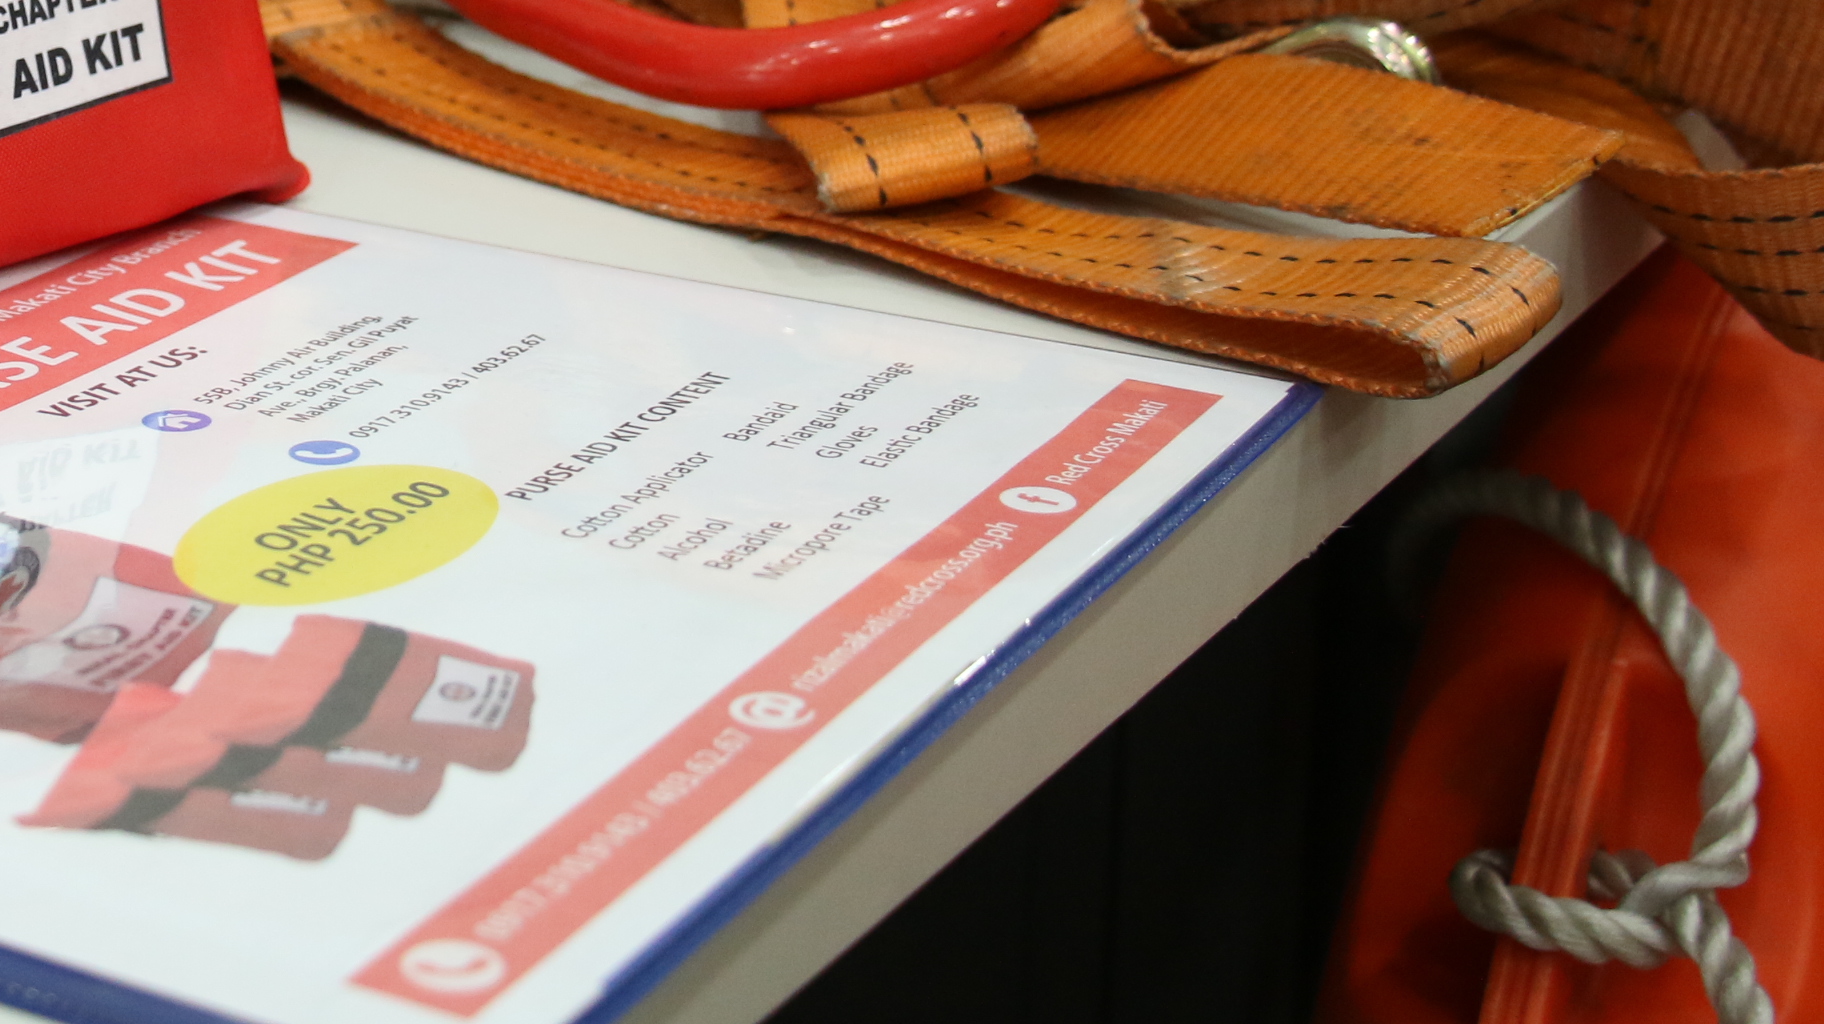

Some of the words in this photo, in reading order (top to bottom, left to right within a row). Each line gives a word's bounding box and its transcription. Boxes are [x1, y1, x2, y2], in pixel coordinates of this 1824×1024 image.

[12, 46, 74, 100] AID
[81, 23, 145, 75] KIT
[59, 288, 186, 346] AID
[165, 239, 282, 293] KIT
[66, 260, 127, 287] City
[110, 228, 204, 265] Branch
[37, 381, 119, 419] VISIT
[114, 366, 160, 388] AT
[152, 345, 209, 371] US:
[224, 389, 273, 411] Dian
[266, 377, 295, 392] St.
[290, 364, 324, 381] cor.
[314, 349, 357, 366] Sen.
[347, 334, 379, 349] Gil
[368, 315, 419, 338] Puyat
[230, 356, 295, 388] Johnny
[287, 345, 317, 359] Air
[287, 392, 352, 423] Makati
[343, 377, 383, 396] City
[295, 375, 346, 399] Brgy.
[334, 343, 409, 378] Palanan,
[348, 377, 470, 438] 0917.310.9143
[471, 333, 546, 375] 403.62.67
[504, 462, 586, 501] PURSE
[571, 441, 618, 464] AID
[603, 421, 650, 442] KIT
[637, 371, 731, 422] CONTENT
[722, 401, 799, 442] Bandaid
[766, 400, 856, 450] Triangular
[839, 361, 914, 402] Bandage
[816, 424, 879, 459] Gloves
[859, 433, 922, 469] Elastic
[905, 393, 980, 434] Bandage
[1044, 462, 1093, 486] Red
[1076, 434, 1126, 465] Cross
[1106, 399, 1169, 437] Makati
[254, 497, 357, 553] ONLY
[561, 503, 634, 539] Cotton
[620, 451, 714, 506] Applicator
[608, 513, 681, 550] Cotton
[254, 543, 336, 588] PHP
[327, 481, 450, 547] 250.00
[657, 517, 734, 561] Alcohol
[703, 520, 792, 570] Betadine
[752, 522, 853, 581] Micropore
[833, 495, 891, 521] Tape
